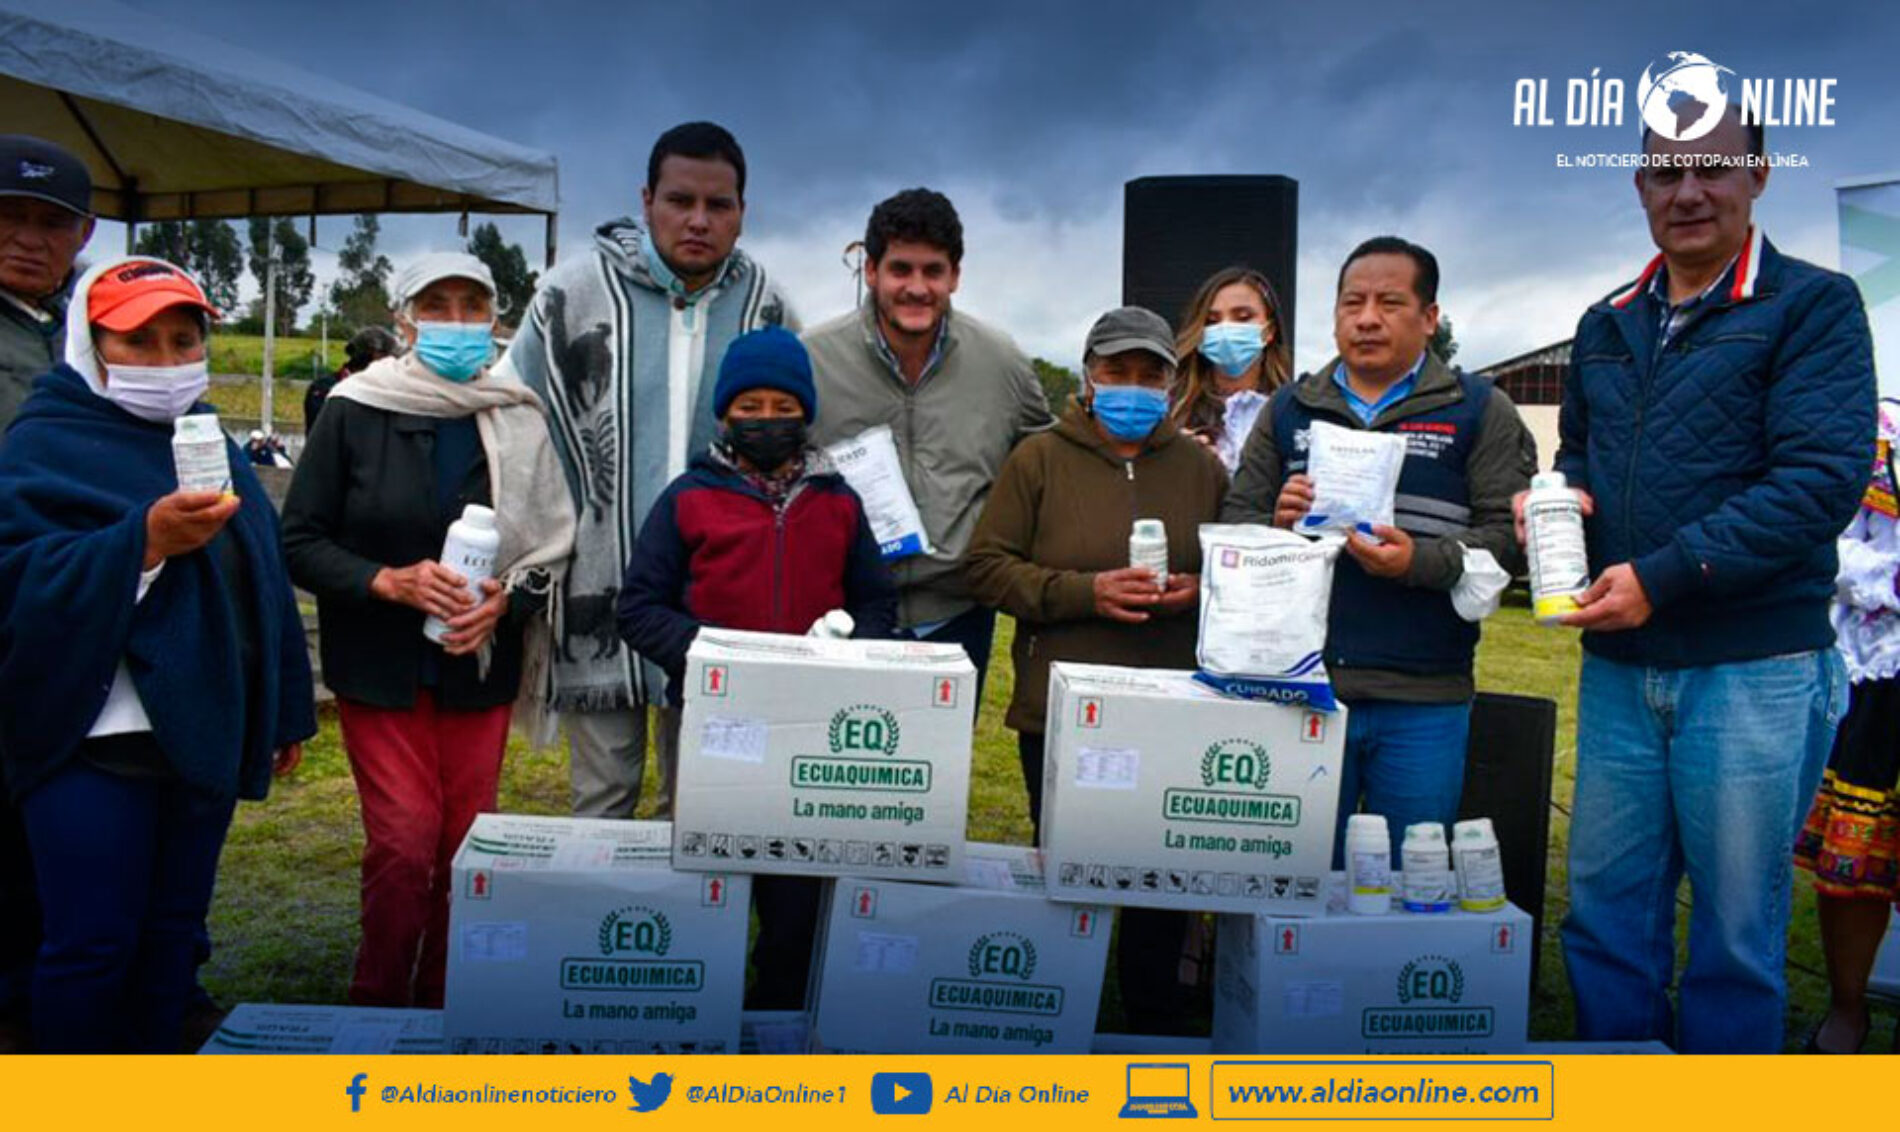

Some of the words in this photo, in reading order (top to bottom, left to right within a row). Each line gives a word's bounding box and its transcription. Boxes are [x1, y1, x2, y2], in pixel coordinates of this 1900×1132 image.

[1243, 553, 1296, 567] Ridomil
[1225, 683, 1309, 701] CUIDADO
[845, 720, 883, 751] EQ
[798, 762, 924, 787] ECUAQUIMICA
[1217, 753, 1253, 784] EQ
[793, 798, 814, 816] La
[819, 802, 867, 820] mano
[871, 801, 924, 826] amiga
[1170, 795, 1293, 820] ECUAQUIMICA
[1165, 829, 1185, 849] La
[1189, 834, 1236, 852] mano
[1241, 834, 1292, 859] amiga
[616, 921, 655, 951] EQ
[984, 945, 1020, 975] EQ
[568, 965, 696, 985] ECUAQUIMICA
[1413, 971, 1450, 999] EQ
[937, 984, 1056, 1010] ECUAQUIMICA
[563, 999, 584, 1018] La
[589, 1002, 638, 1020] mano
[643, 1001, 696, 1024] amiga
[1369, 1014, 1487, 1033] ECUAQUIMICA
[929, 1017, 949, 1036] La
[953, 1021, 998, 1039] mano
[1002, 1022, 1053, 1047] amiga
